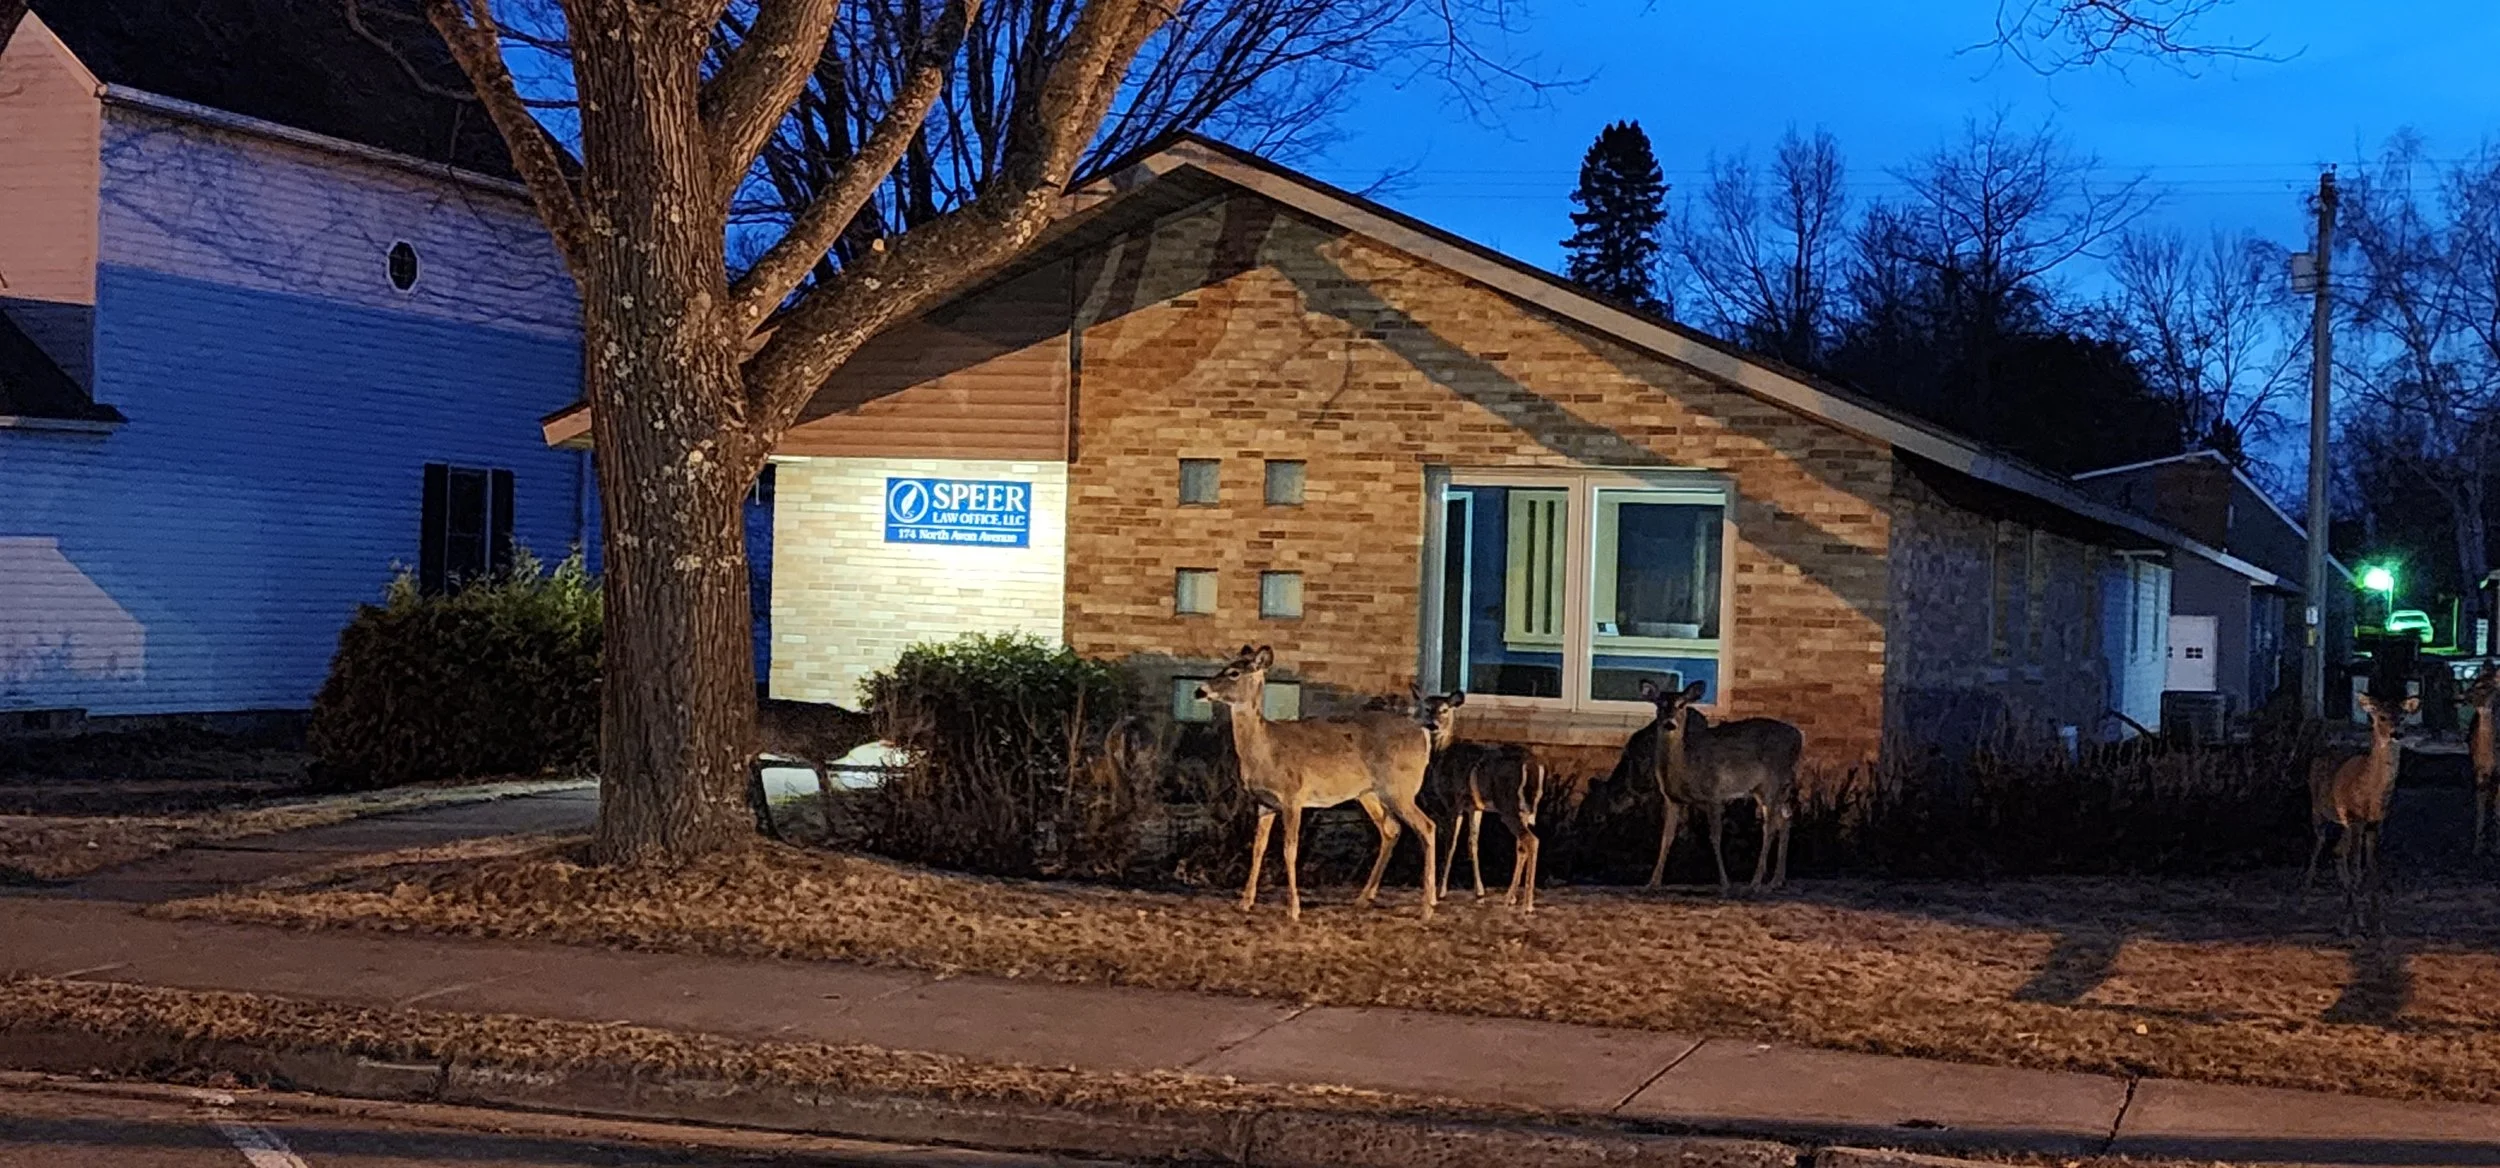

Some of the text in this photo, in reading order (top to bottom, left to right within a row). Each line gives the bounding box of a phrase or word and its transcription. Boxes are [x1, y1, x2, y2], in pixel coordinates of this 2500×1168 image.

[932, 483, 1026, 512] SPEER
[932, 511, 959, 523] LAW
[1003, 514, 1025, 526] LLC
[898, 528, 917, 539] 174
[918, 529, 949, 541] North
[979, 531, 1018, 543] Avenue
